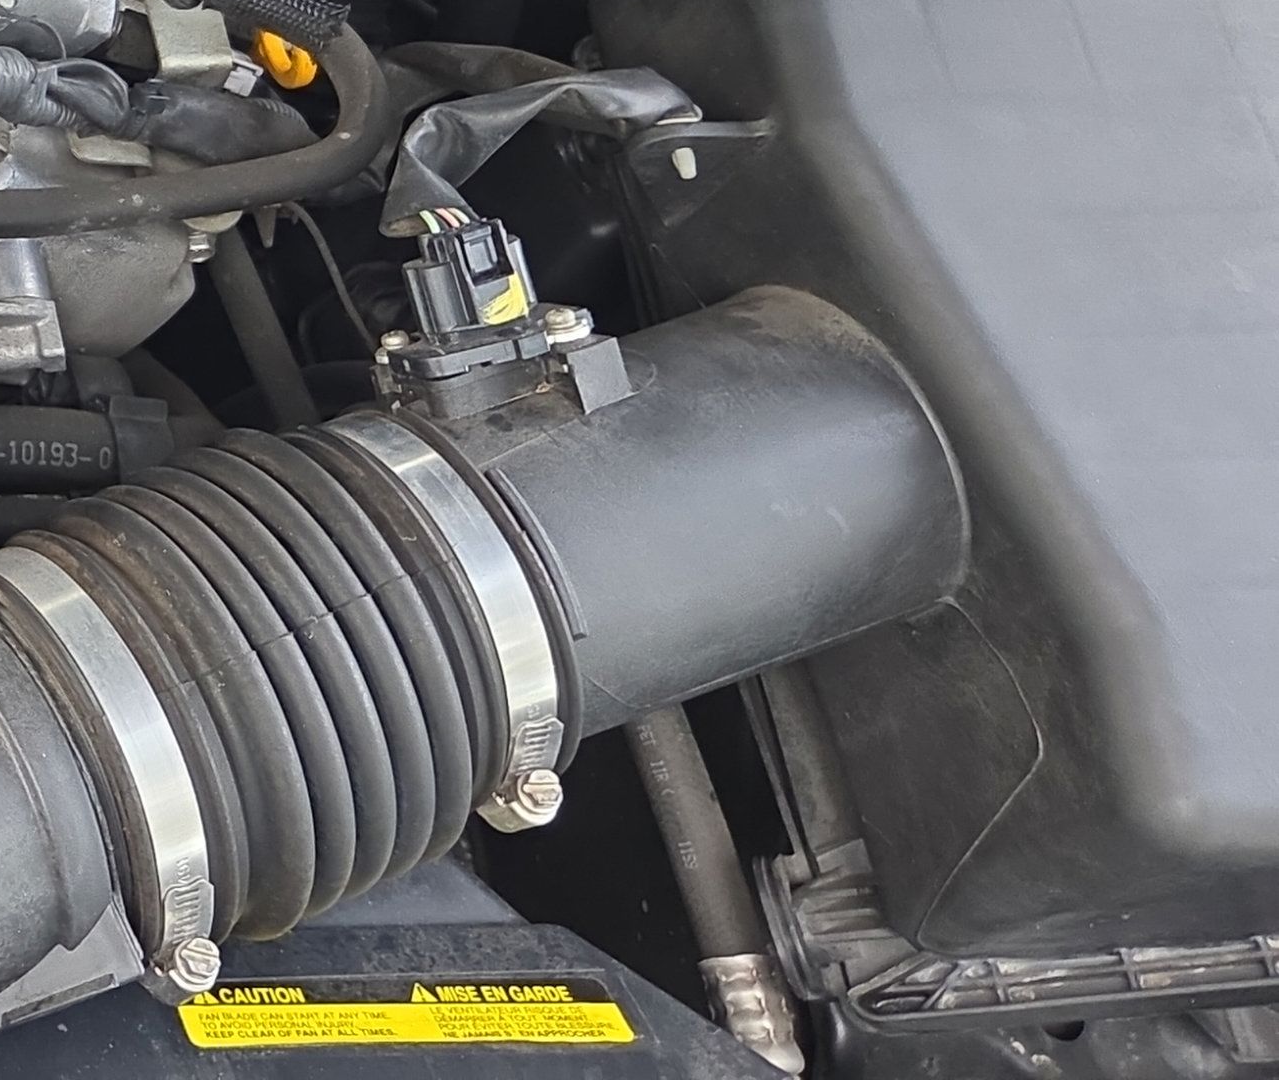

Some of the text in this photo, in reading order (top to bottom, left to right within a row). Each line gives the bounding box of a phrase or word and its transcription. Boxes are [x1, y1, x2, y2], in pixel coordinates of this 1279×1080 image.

[218, 987, 306, 1004] CAUTION
[435, 986, 574, 1002] MISE EN GARDE
[261, 1012, 284, 1020] CAN
[287, 1012, 320, 1020] START
[323, 1012, 336, 1020] AT
[338, 1012, 359, 1020] ANY
[206, 1030, 234, 1039] KEEP
[237, 1030, 275, 1038] CLEAR
[279, 1030, 293, 1038] OF
[321, 1029, 336, 1037] AT
[338, 1029, 358, 1037] ALL
